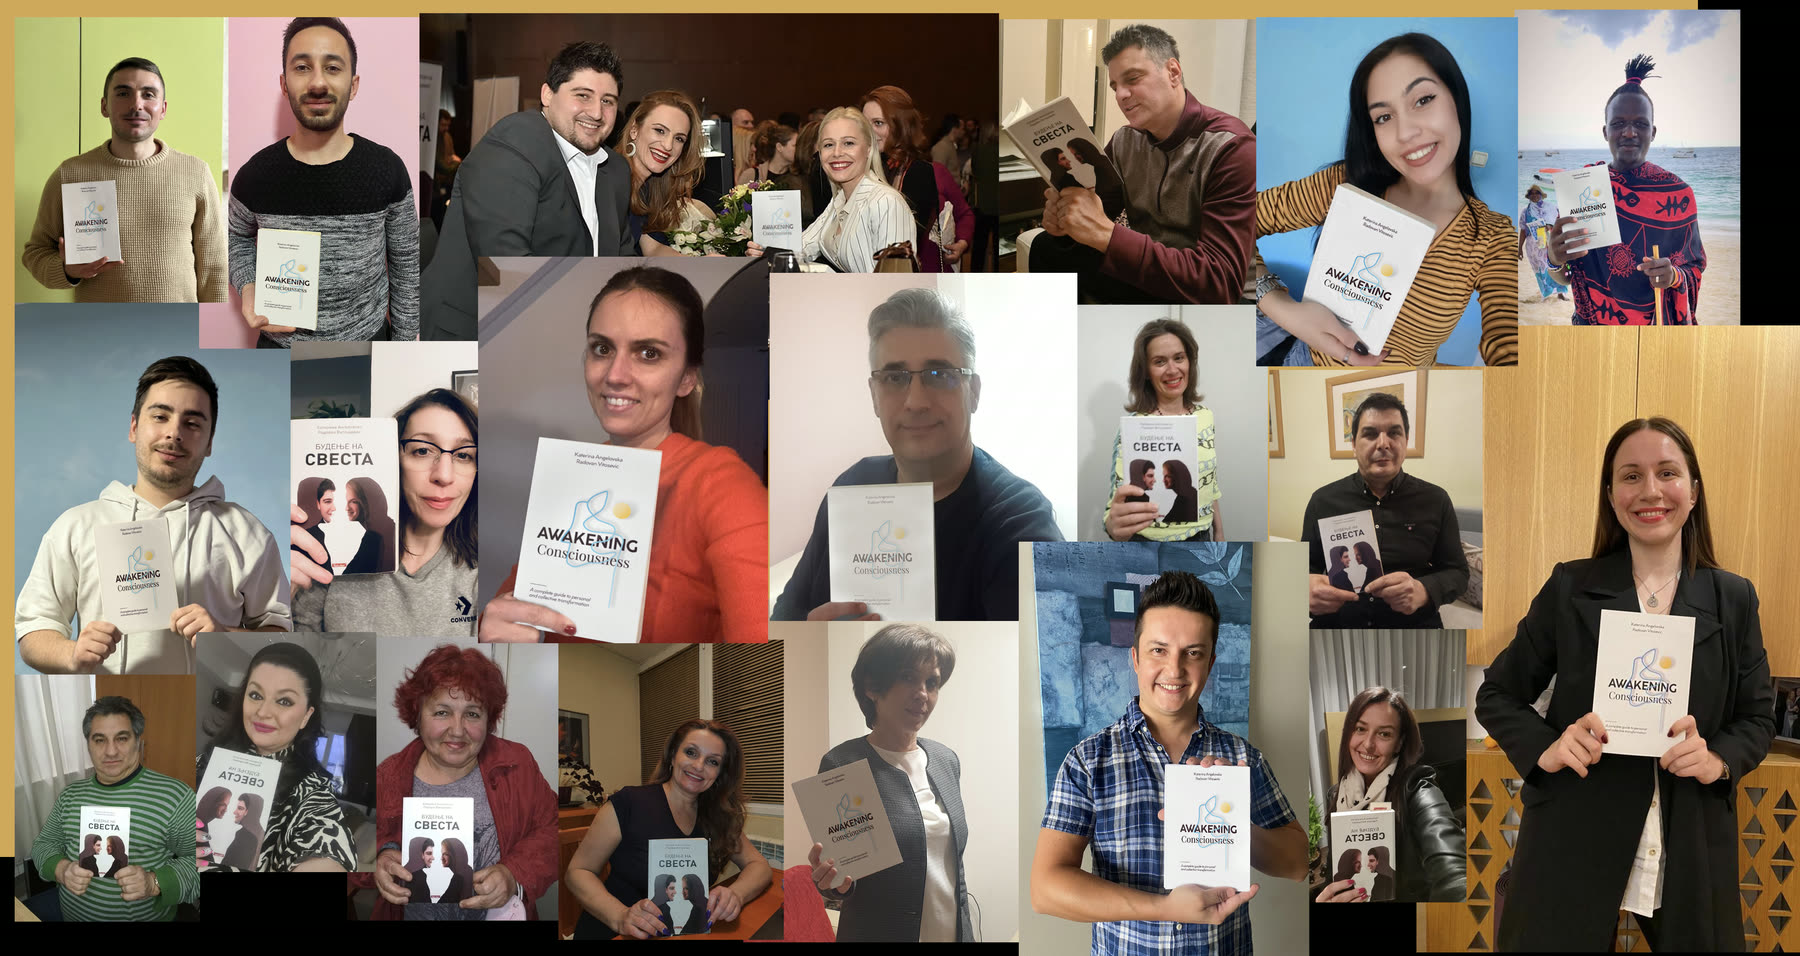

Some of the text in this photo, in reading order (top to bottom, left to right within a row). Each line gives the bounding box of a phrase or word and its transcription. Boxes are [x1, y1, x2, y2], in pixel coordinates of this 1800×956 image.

[1032, 124, 1075, 147] СВЕСТА
[1569, 203, 1607, 215] AWAKENING
[74, 218, 108, 227] AWAKENING
[264, 275, 310, 287] AWAKENING
[1325, 267, 1392, 301] AWAKENING
[265, 283, 307, 293] Consciousness
[1324, 278, 1384, 310] Consciousness
[315, 443, 350, 451] БУДЕЊЕ
[1133, 442, 1182, 452] СВЕСТА
[305, 452, 374, 466] СВЕСТА
[574, 451, 595, 459] Katerina
[537, 526, 638, 553] AWAKENING
[1330, 529, 1365, 542] СВЕСТА
[537, 543, 631, 569] Consciousness
[852, 552, 913, 563] AWAKENING
[115, 569, 161, 583] AWAKENING
[854, 566, 910, 575] Consciousness
[117, 581, 160, 592] Consciousness
[1608, 678, 1677, 693] AWAKENING
[1608, 691, 1673, 705] Consciousness
[88, 822, 120, 831] СВЕСТА
[414, 820, 460, 831] СВЕСТА
[828, 812, 874, 835] AWAKENING
[1179, 824, 1237, 834] AWAKENING
[831, 824, 874, 844] Consciousness
[1180, 835, 1234, 845] Consciousness
[658, 859, 697, 868] СВЕСТА
